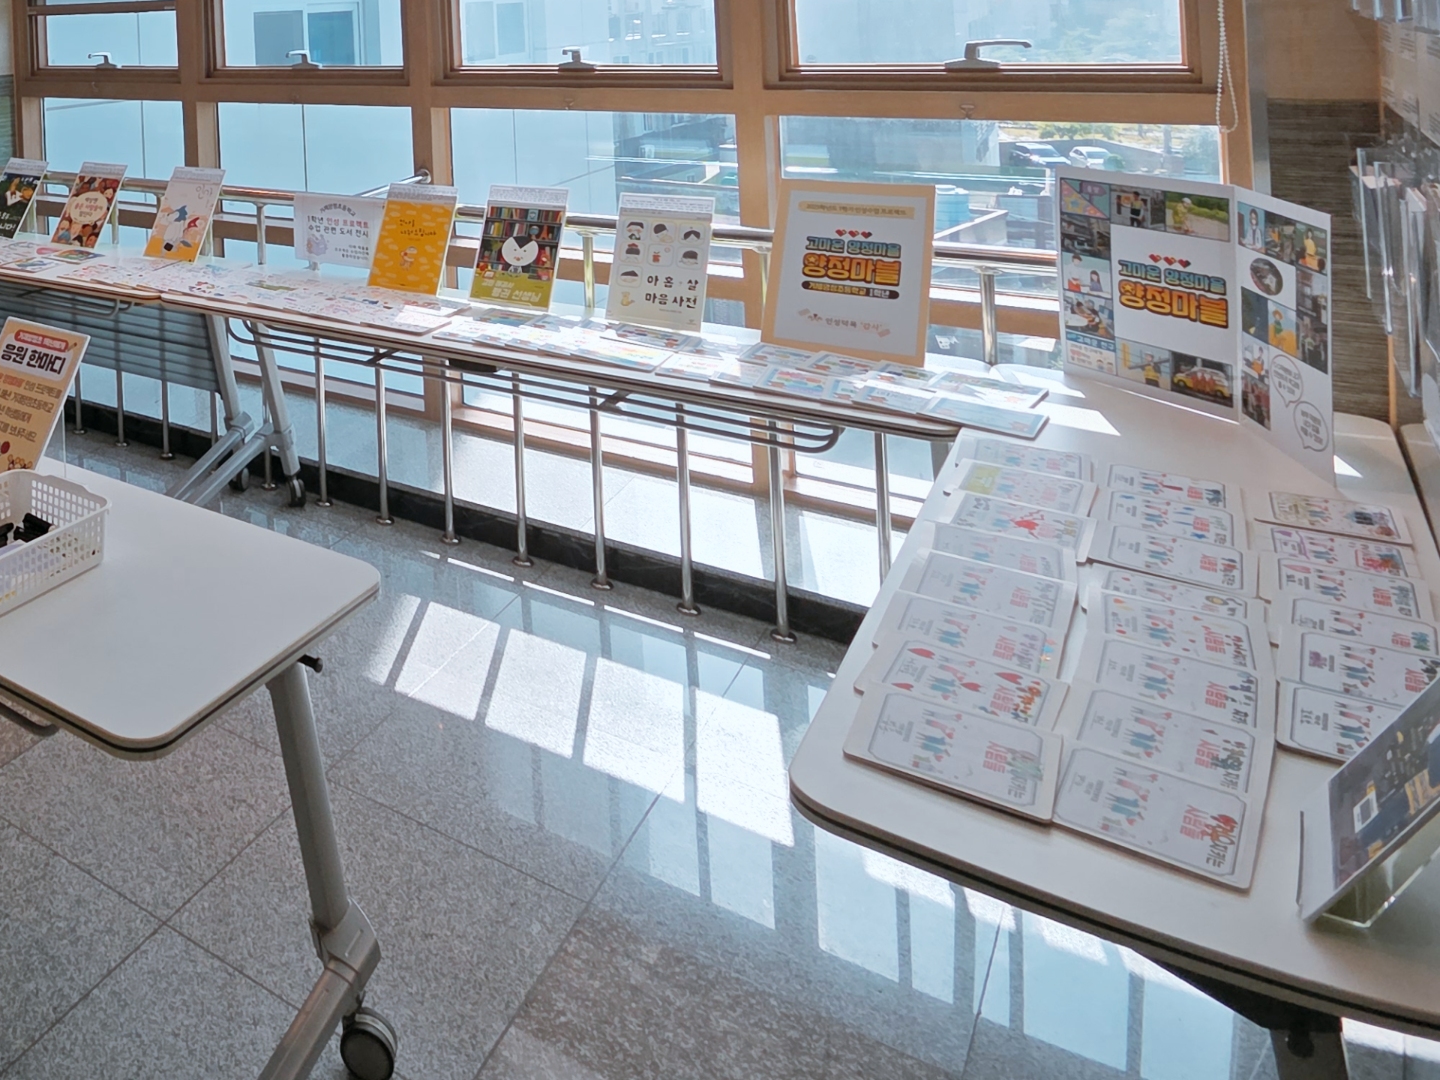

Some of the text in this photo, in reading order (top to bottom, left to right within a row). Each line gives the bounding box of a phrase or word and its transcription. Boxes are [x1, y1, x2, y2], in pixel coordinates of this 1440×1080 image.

[308, 224, 321, 233] 수업
[339, 227, 353, 237] 도서
[355, 229, 369, 239] 전시
[342, 219, 369, 229] 프로젝트
[805, 235, 902, 259] 고마운 양정마을
[802, 252, 902, 287] 양정마블
[1118, 259, 1227, 296] 고마운 양정마을
[511, 289, 542, 303] 선생님
[1118, 279, 1229, 330] 양정마블
[0, 343, 67, 375] 응원 한마디
